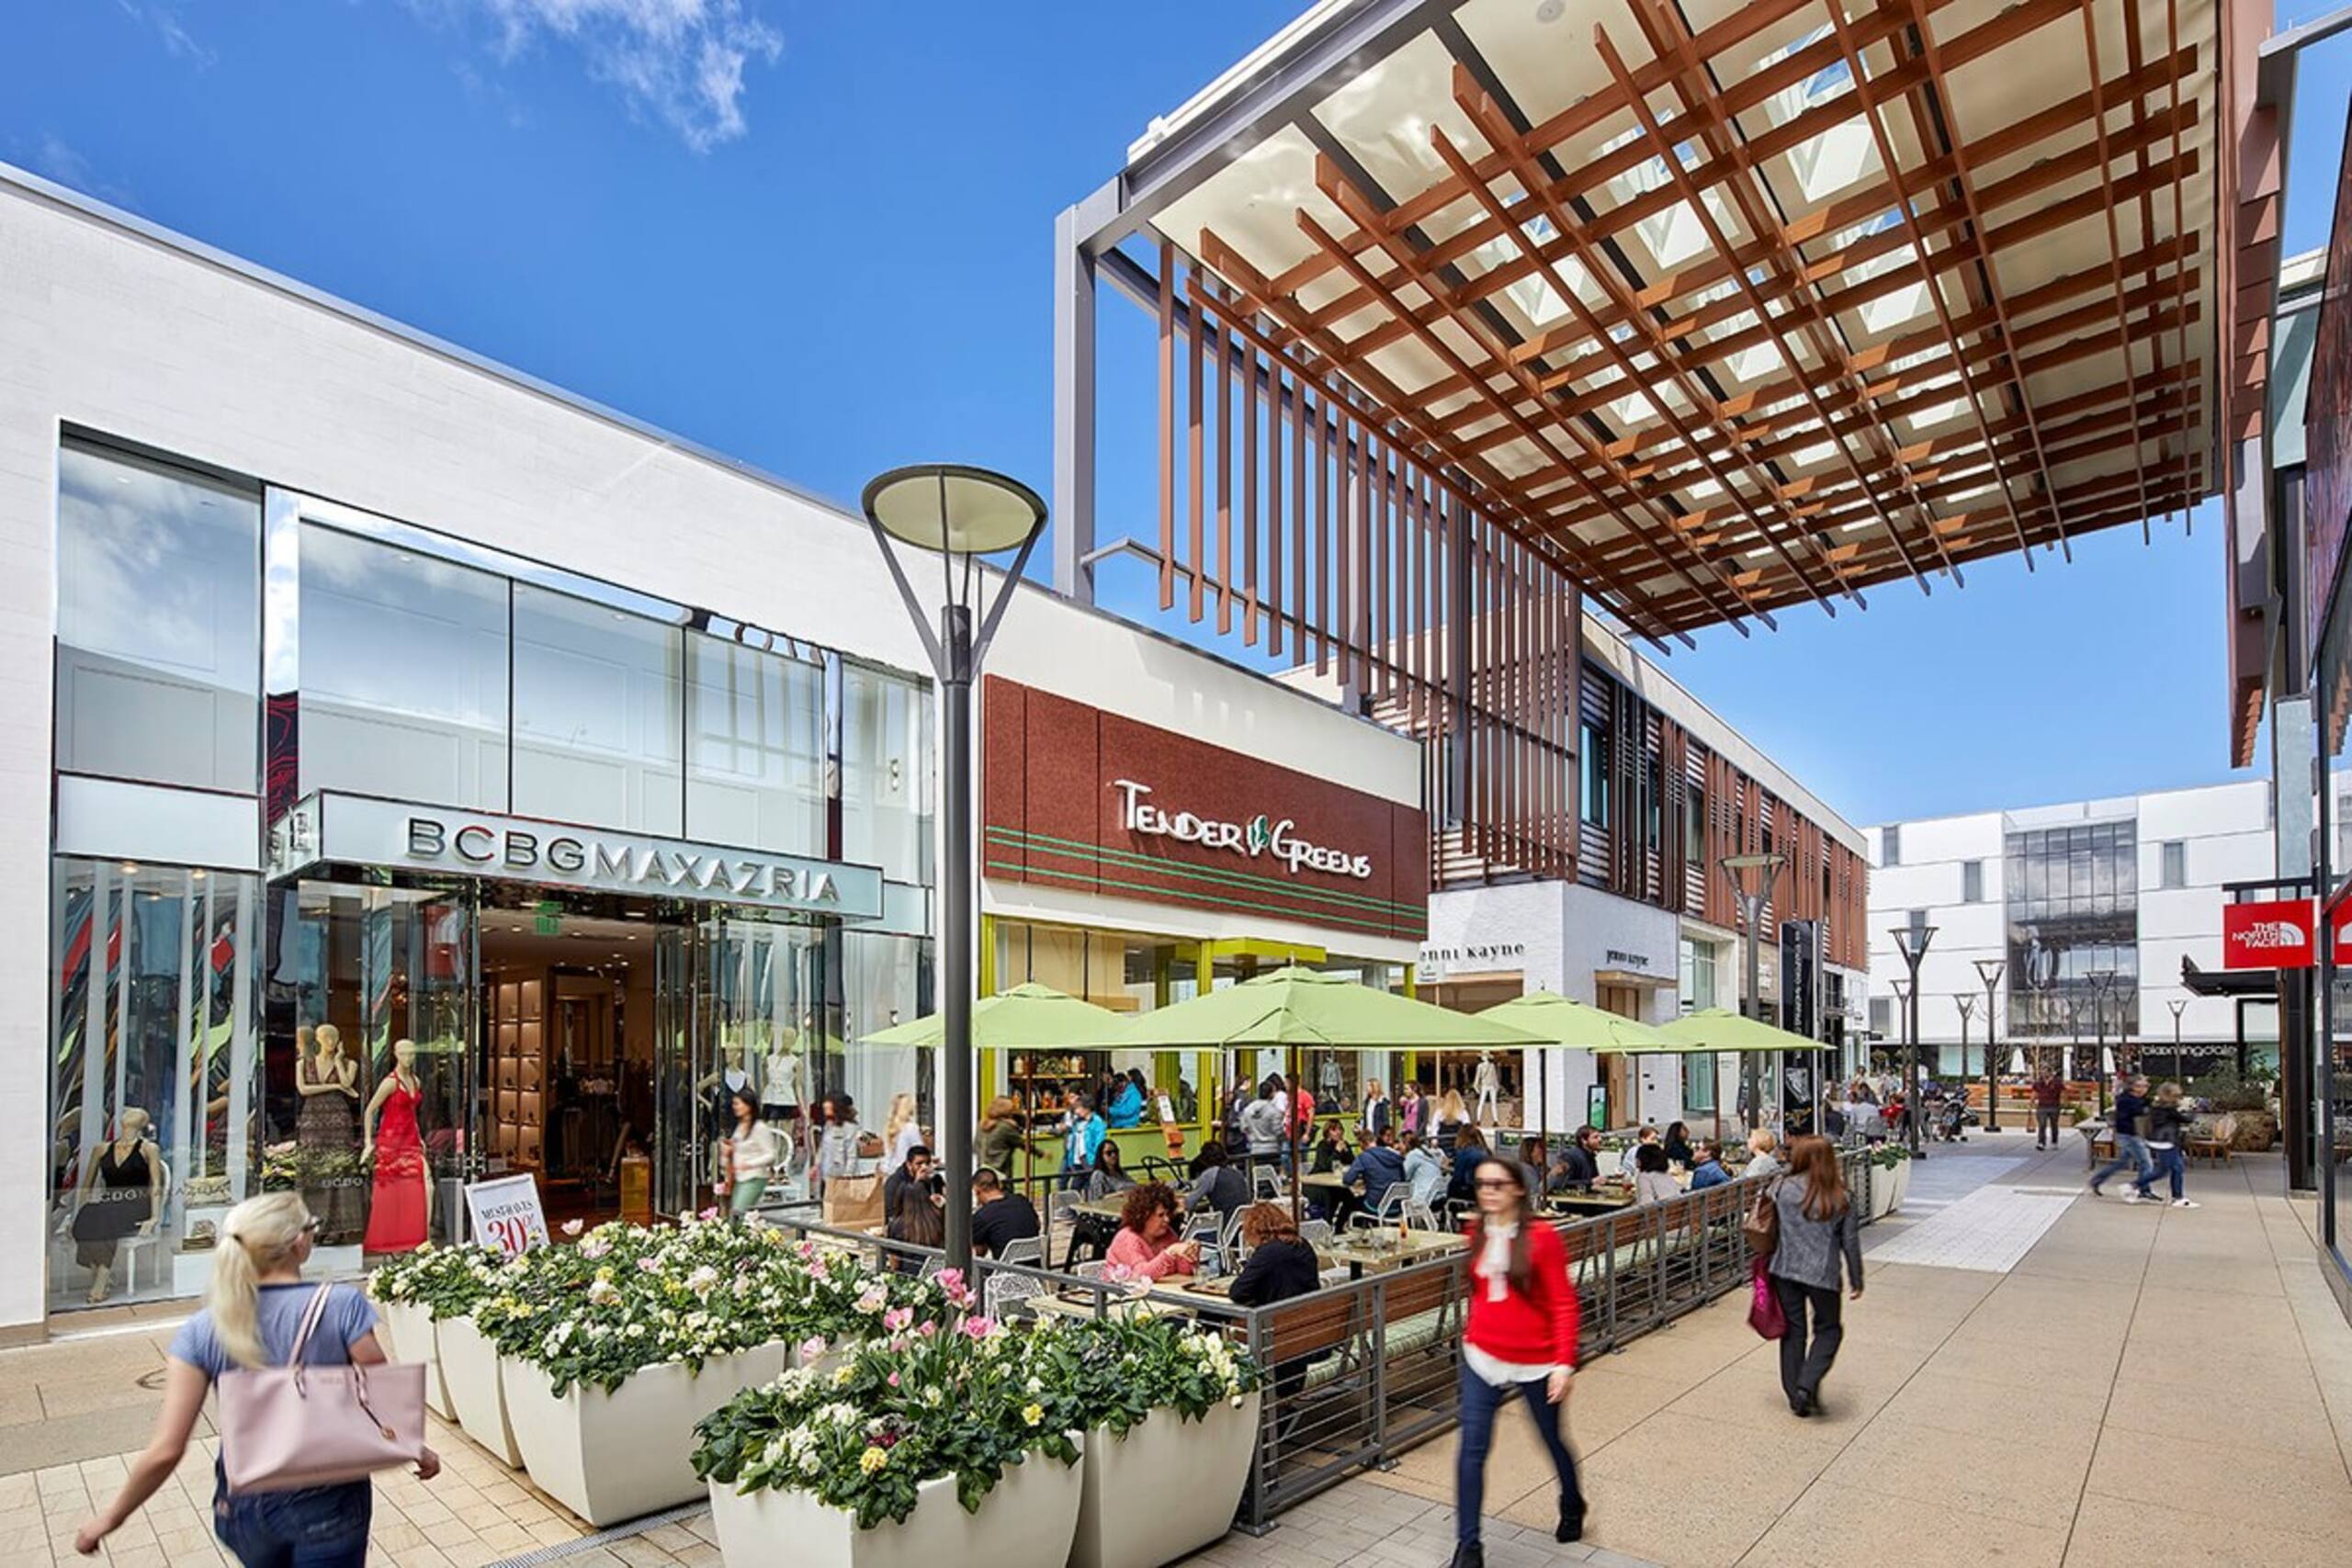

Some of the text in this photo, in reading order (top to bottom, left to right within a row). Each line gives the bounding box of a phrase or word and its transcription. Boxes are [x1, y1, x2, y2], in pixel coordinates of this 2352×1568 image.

[1114, 779, 1245, 853] TENDER
[405, 816, 842, 904] BCBGMAXAZRIA
[2252, 921, 2279, 931] THE
[2232, 930, 2279, 942] NORTH
[2245, 939, 2279, 948] FACE
[1419, 943, 1524, 963] enni kayne
